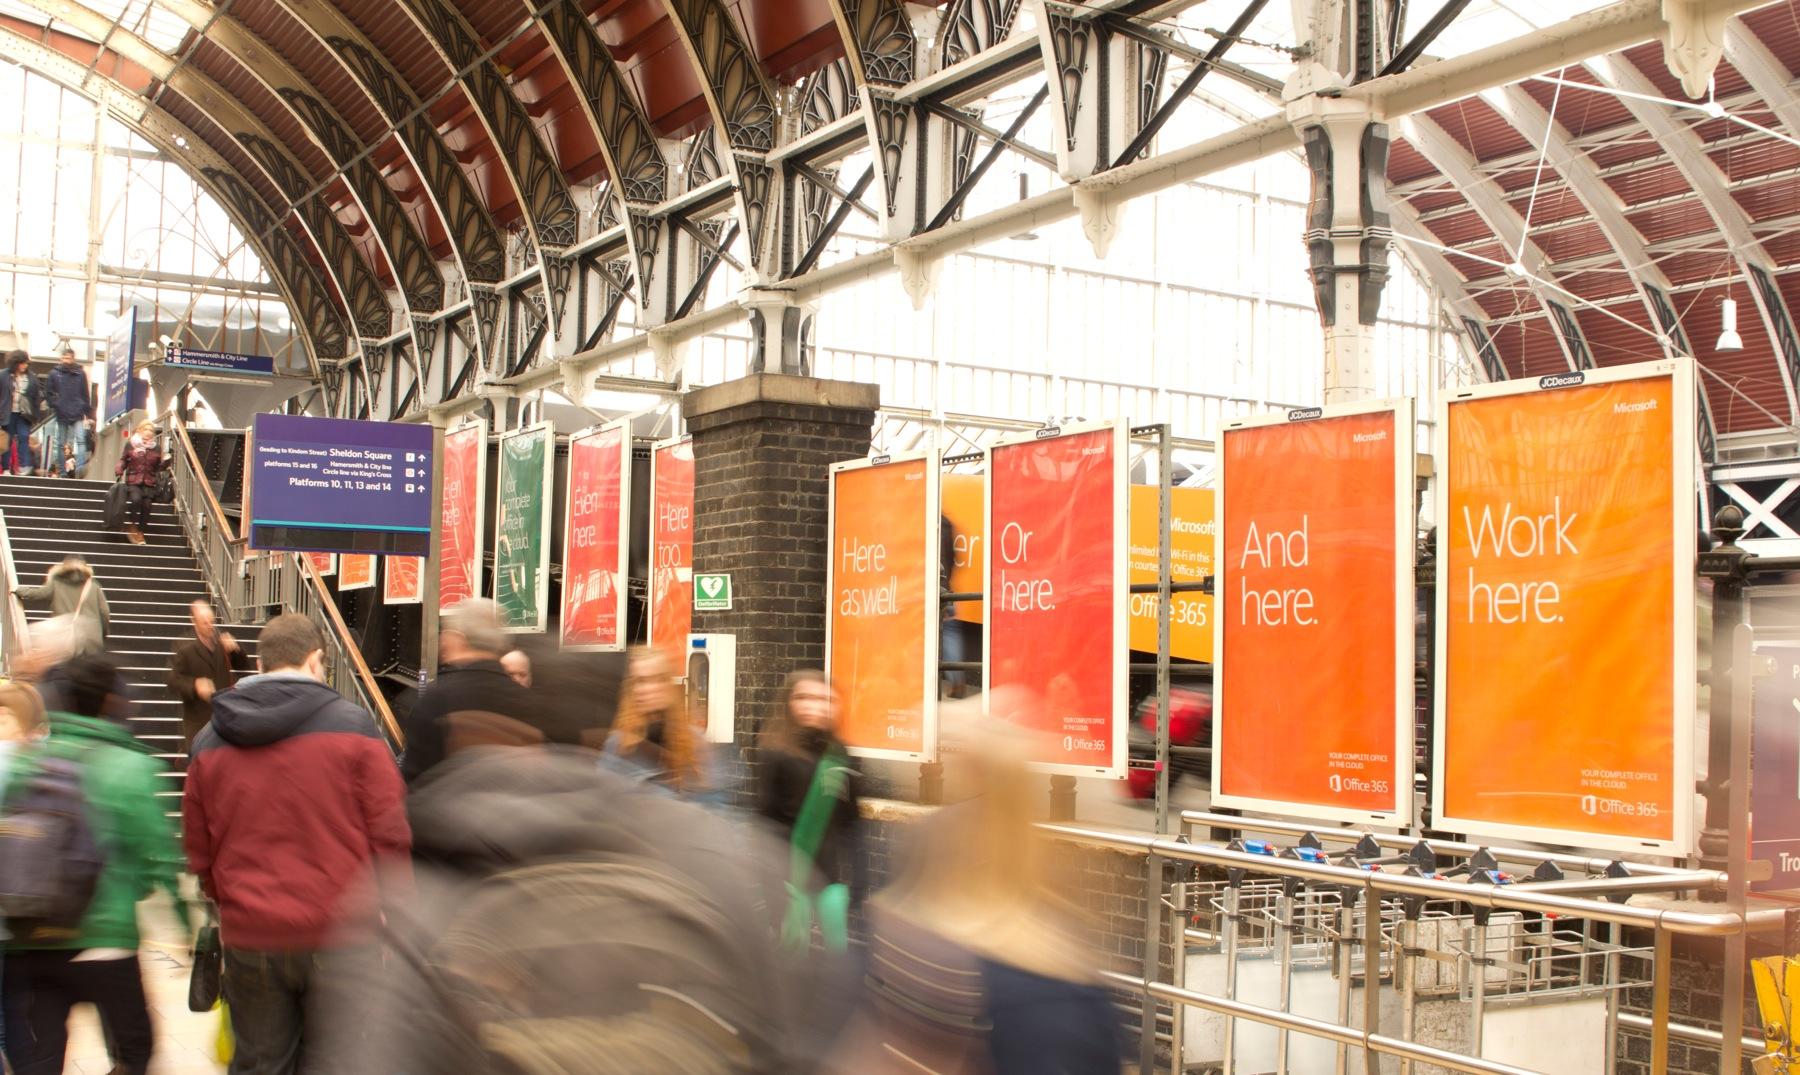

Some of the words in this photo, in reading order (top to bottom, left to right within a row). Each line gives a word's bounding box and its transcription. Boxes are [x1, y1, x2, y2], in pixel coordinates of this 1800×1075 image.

[182, 350, 221, 360] Hammersmith
[1541, 376, 1583, 388] JCDecaux
[1289, 410, 1320, 420] JCDecaux
[1613, 399, 1657, 414] Microsoft
[1353, 430, 1387, 443] Microsoft
[329, 448, 363, 459] Sheldon
[363, 450, 392, 460] Square
[264, 460, 291, 468] platforms
[359, 470, 376, 479] King's
[289, 477, 330, 488] Platforms
[354, 481, 365, 490] 13
[365, 482, 381, 491] and
[381, 482, 392, 491] 14
[574, 488, 599, 517] Even
[659, 504, 690, 534] Here
[1170, 517, 1216, 535] Microsoft
[1463, 496, 1579, 559] Work
[1001, 522, 1034, 564] Or
[1240, 514, 1308, 569] And
[658, 544, 683, 569] too.
[842, 536, 886, 573] Here
[953, 534, 980, 568] er
[1128, 544, 1156, 557] nlimited
[1190, 552, 1197, 561] in
[1196, 552, 1211, 564] this
[1134, 561, 1159, 572] courtes
[1173, 563, 1195, 577] Office
[1195, 568, 1209, 577] 365
[840, 588, 860, 616] as
[861, 575, 899, 614] well.
[1001, 569, 1056, 612] here.
[1469, 567, 1564, 624] here.
[1241, 576, 1319, 625] here.
[1130, 594, 1176, 622] Offie
[1176, 600, 1207, 627] 365
[1074, 738, 1092, 750] Office
[1091, 739, 1106, 751] 365
[1343, 752, 1370, 761] COMPLETE
[1369, 754, 1388, 762] OFFICE
[1581, 769, 1600, 777] YOUR
[1599, 769, 1635, 780] COMPLETE
[1634, 772, 1659, 782] OFFICE
[1581, 779, 1589, 787] IN
[1588, 780, 1602, 788] THE
[1343, 778, 1371, 792] Office
[1370, 780, 1389, 793] 365
[1600, 799, 1635, 816] Office
[1635, 801, 1659, 817] 365
